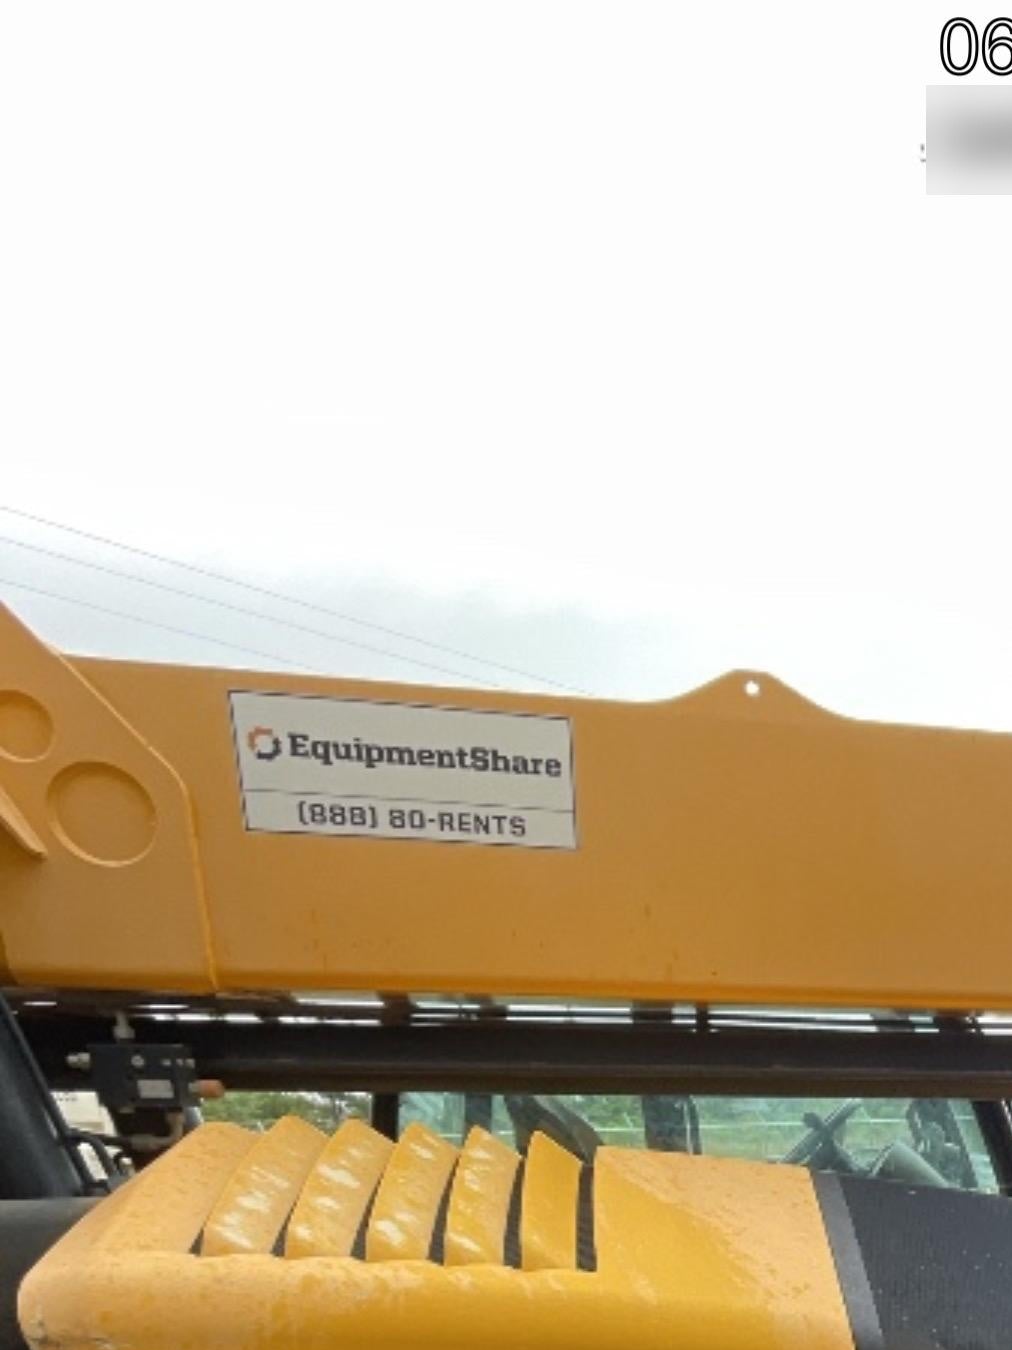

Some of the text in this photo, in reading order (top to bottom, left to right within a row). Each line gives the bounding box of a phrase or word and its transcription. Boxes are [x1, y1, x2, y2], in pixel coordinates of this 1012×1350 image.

[288, 732, 562, 777] EquipmentShare
[298, 799, 527, 837] (888) 80-RENTS
